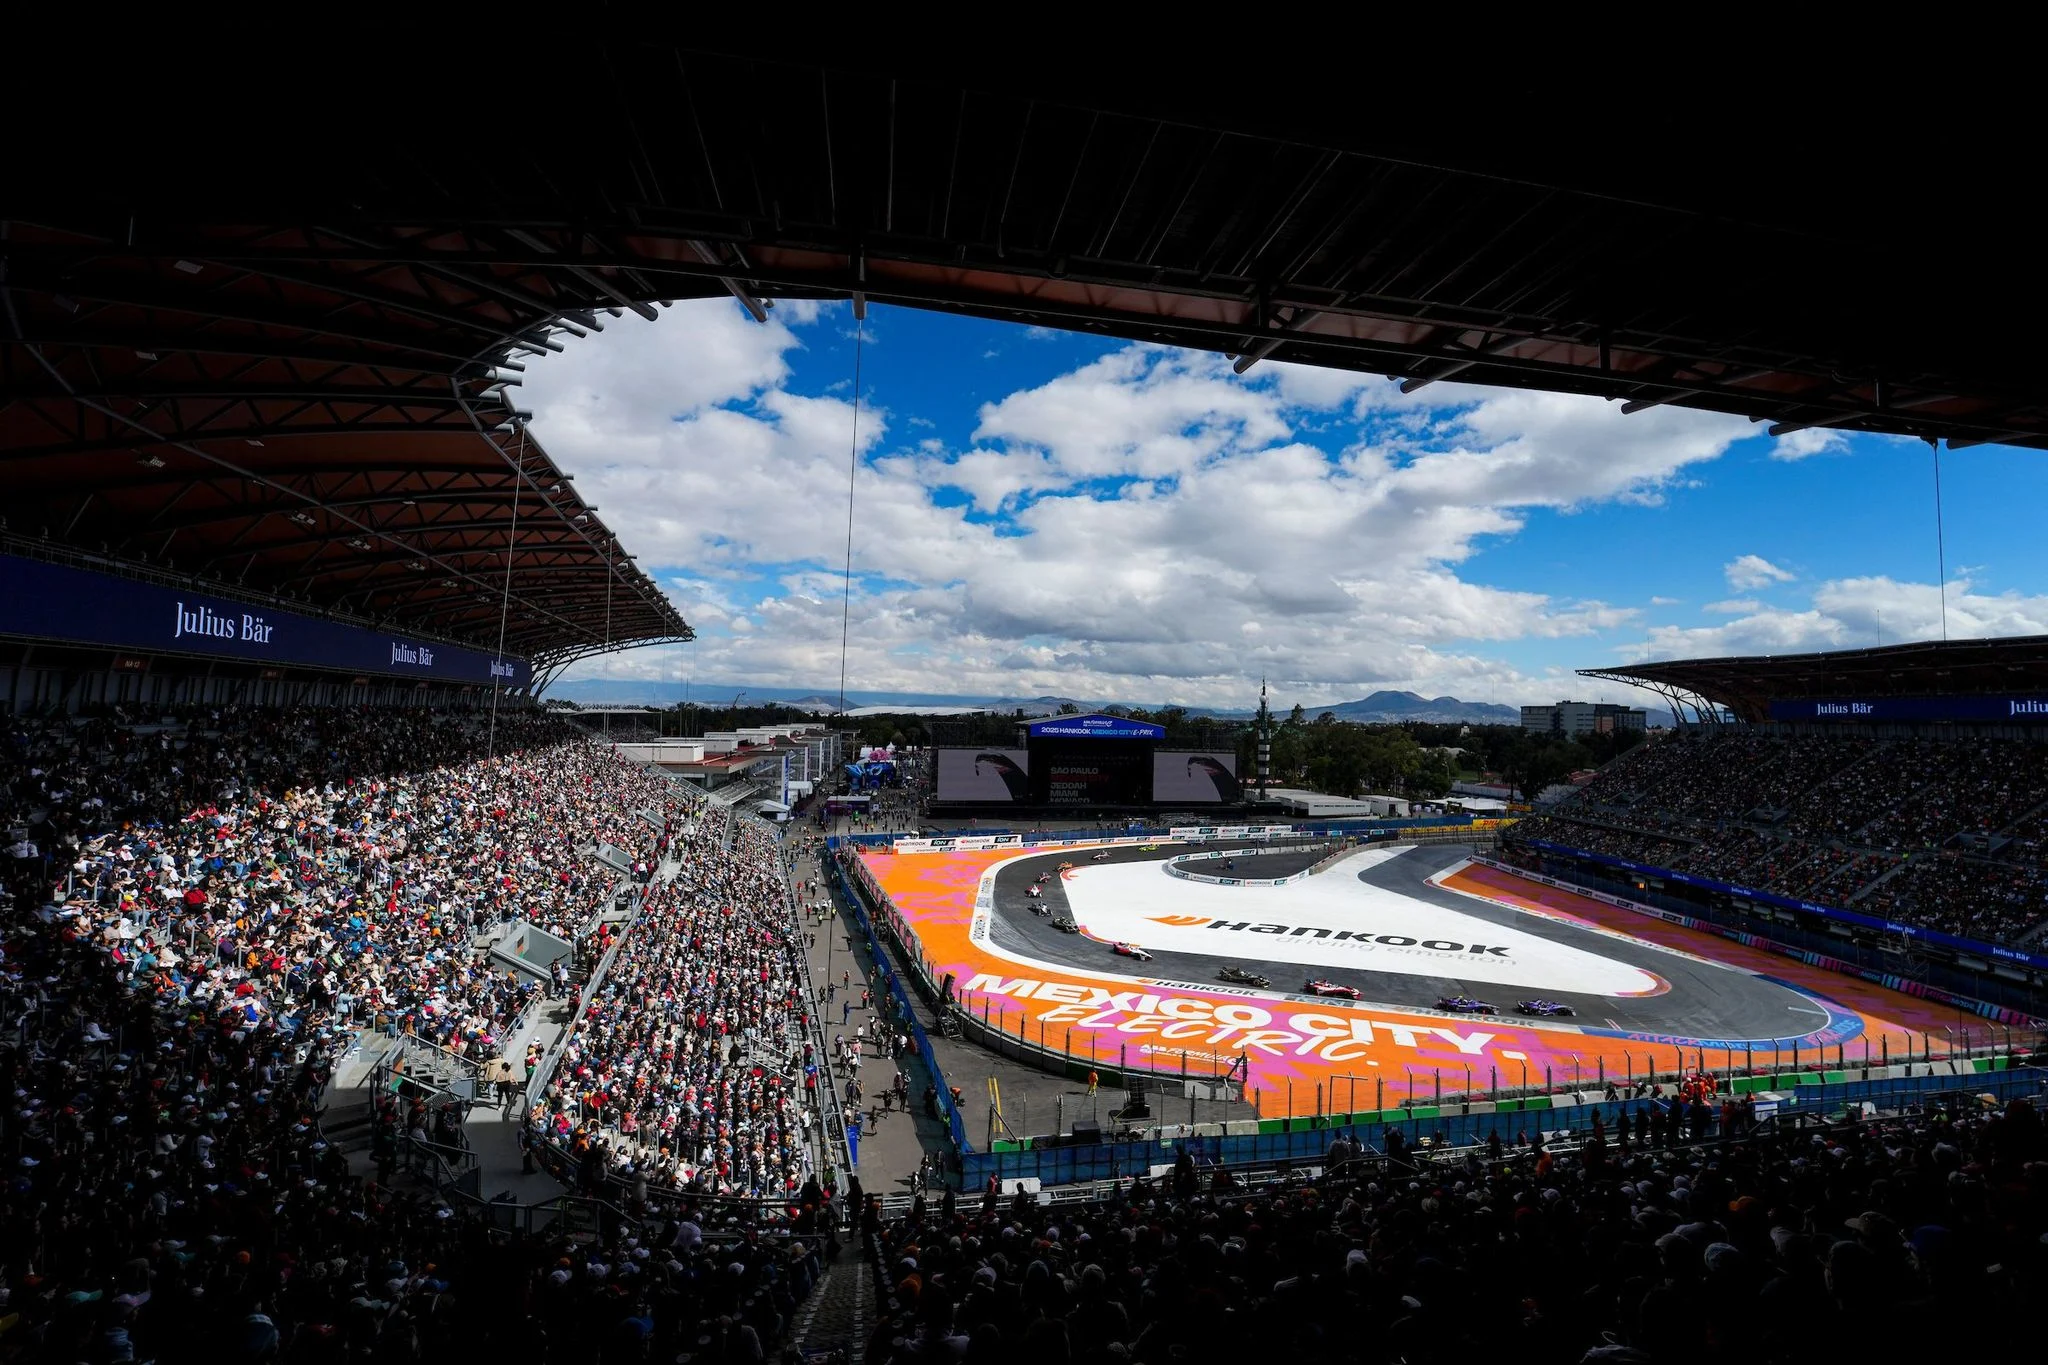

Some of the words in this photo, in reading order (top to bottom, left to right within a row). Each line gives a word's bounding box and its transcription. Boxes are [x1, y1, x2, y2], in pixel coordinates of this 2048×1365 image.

[175, 602, 235, 639] Julius
[241, 614, 273, 643] Bär
[391, 642, 417, 665] Julius
[418, 647, 434, 666] Bär
[490, 660, 504, 677] Julius
[505, 663, 514, 677] Bär
[1817, 703, 1848, 716] Julius
[1851, 702, 1874, 714] Bär
[1041, 726, 1059, 734] 2025
[1886, 922, 1903, 932] Julius
[1903, 926, 1917, 935] Bär
[1275, 936, 1377, 953] driving
[1387, 947, 1518, 966] emotion
[1992, 946, 2014, 959] Julius
[2015, 950, 2031, 962] Bär
[961, 974, 1273, 1028] MEXICO
